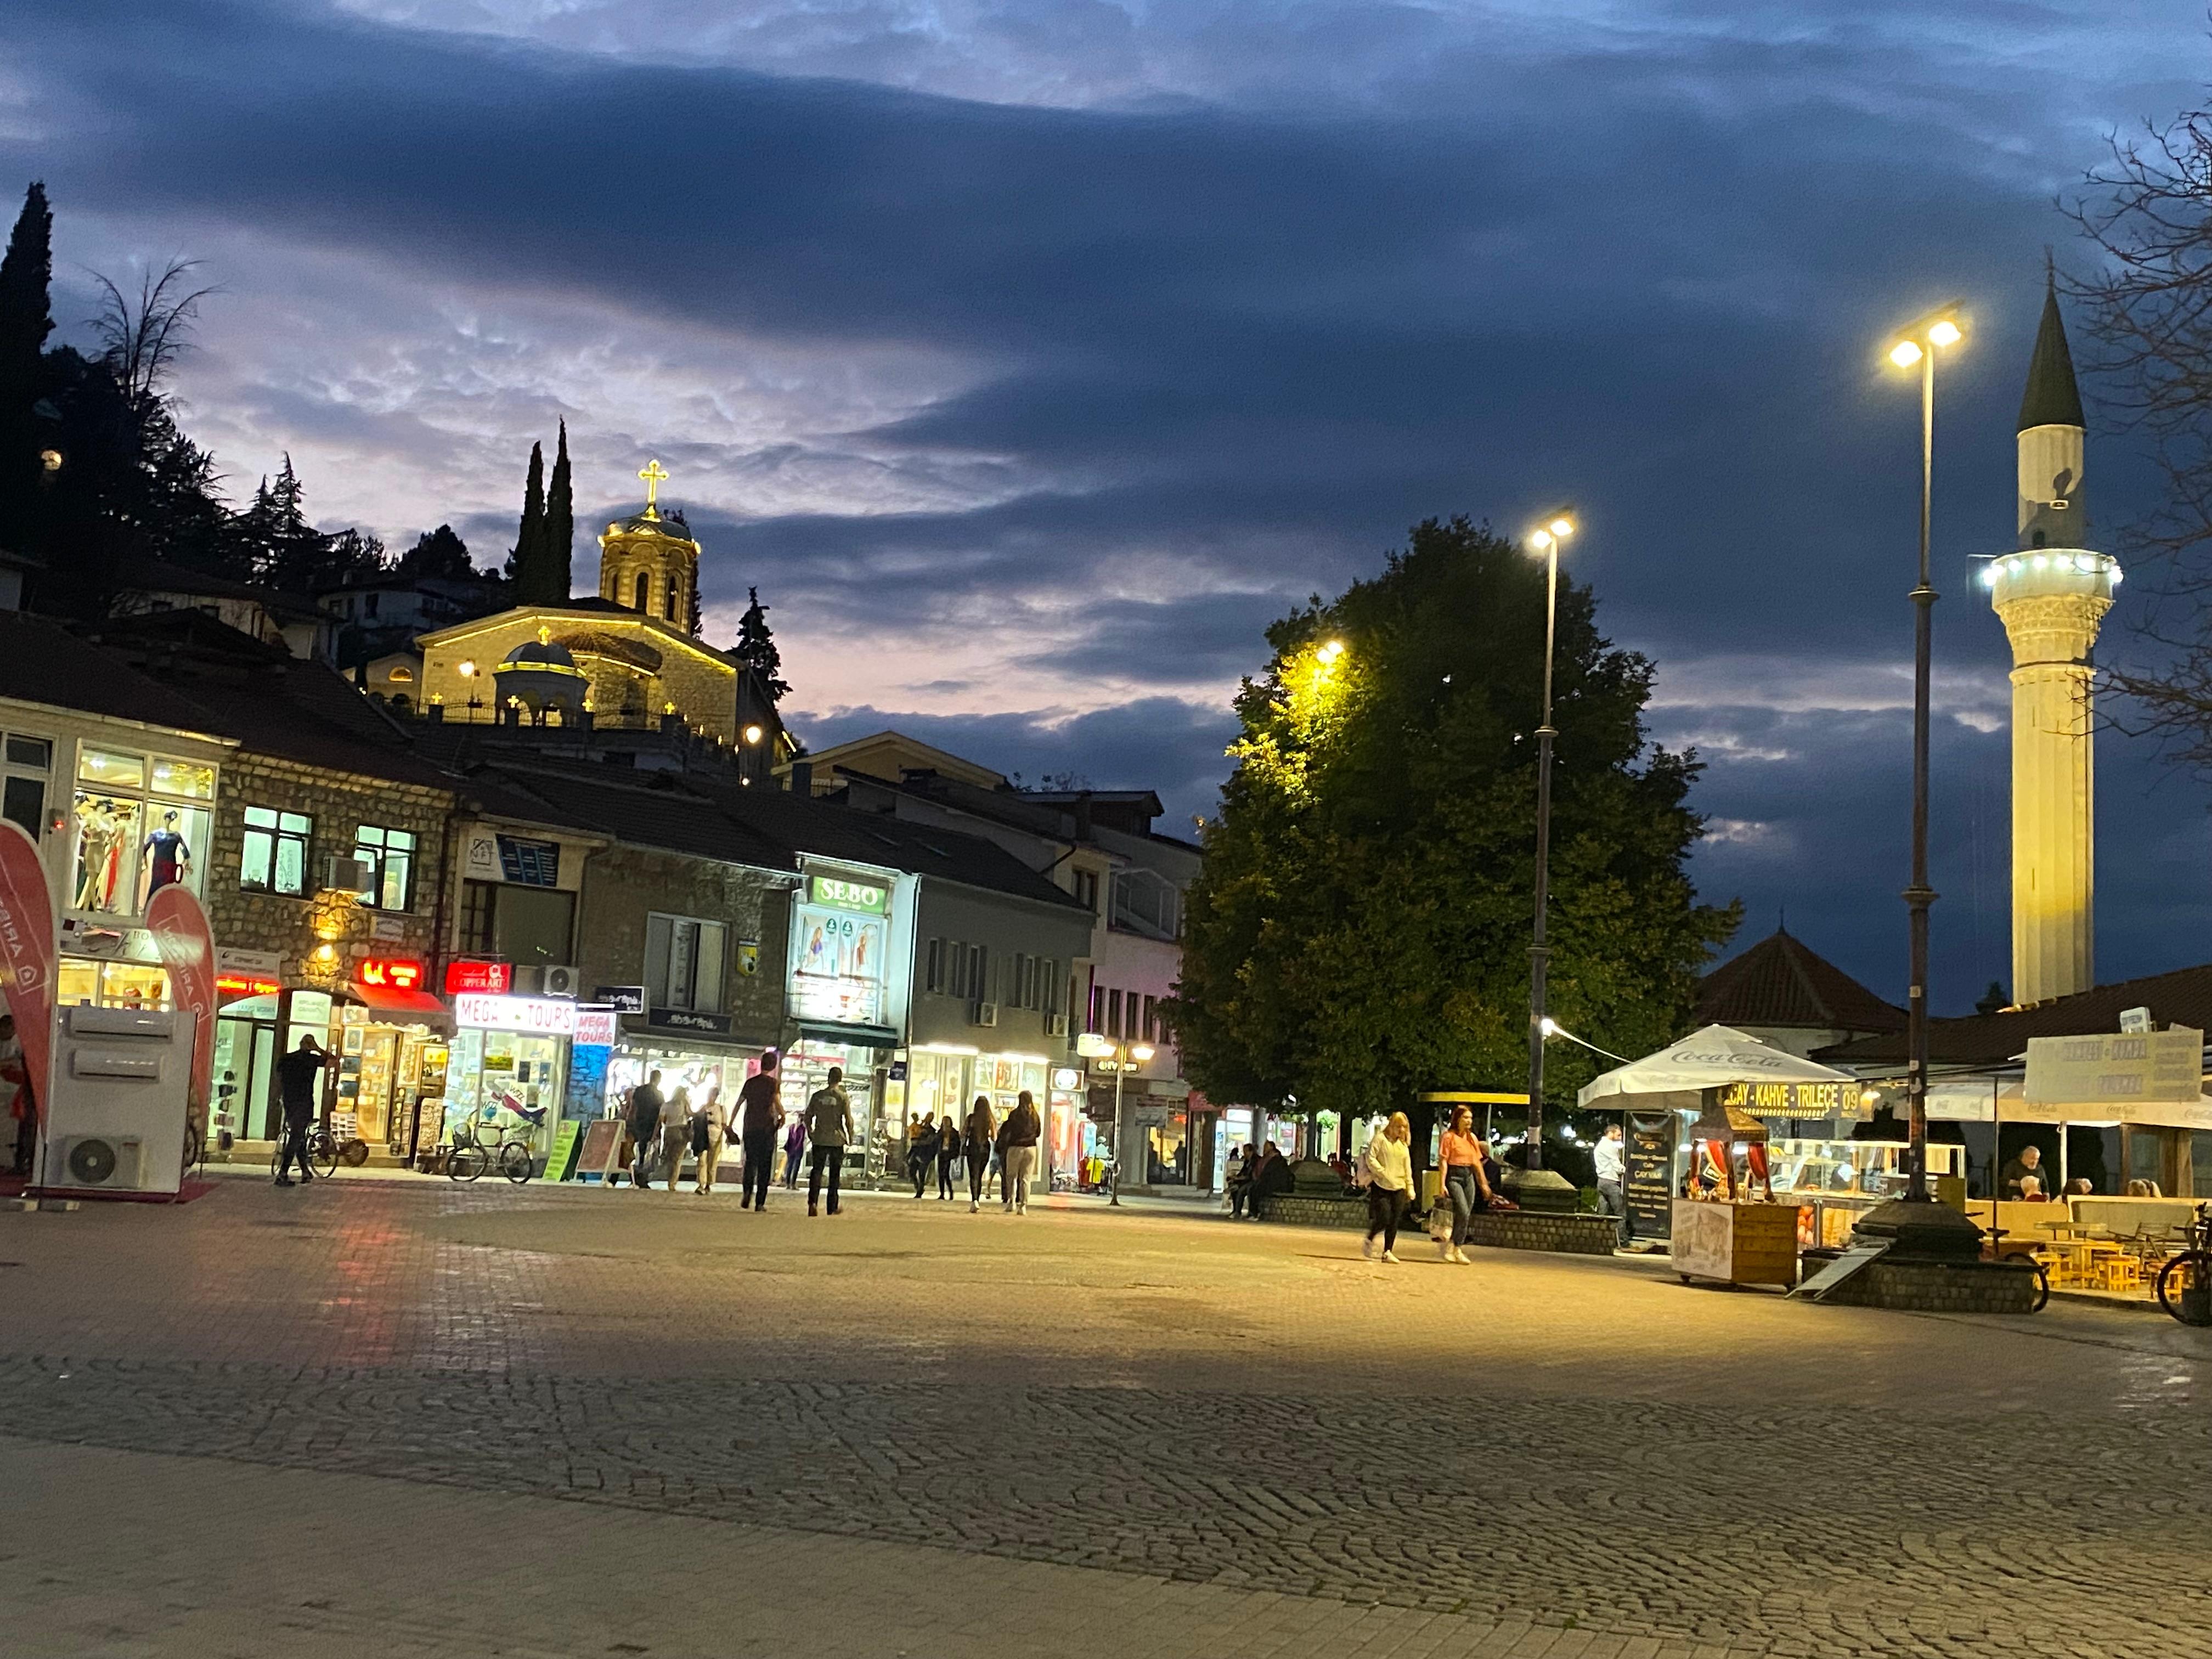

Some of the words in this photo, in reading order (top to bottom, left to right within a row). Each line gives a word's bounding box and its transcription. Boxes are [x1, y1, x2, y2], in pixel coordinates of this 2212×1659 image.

[820, 879, 878, 906] SEBO
[461, 999, 498, 1023] MEGA
[528, 1005, 571, 1029] TOURS
[578, 1015, 611, 1028] MEGA
[575, 1031, 613, 1042] TOURS
[1756, 1084, 1789, 1107] KAHVE
[1796, 1084, 1838, 1110] TRILEÇE
[1842, 1091, 1859, 1110] 09
